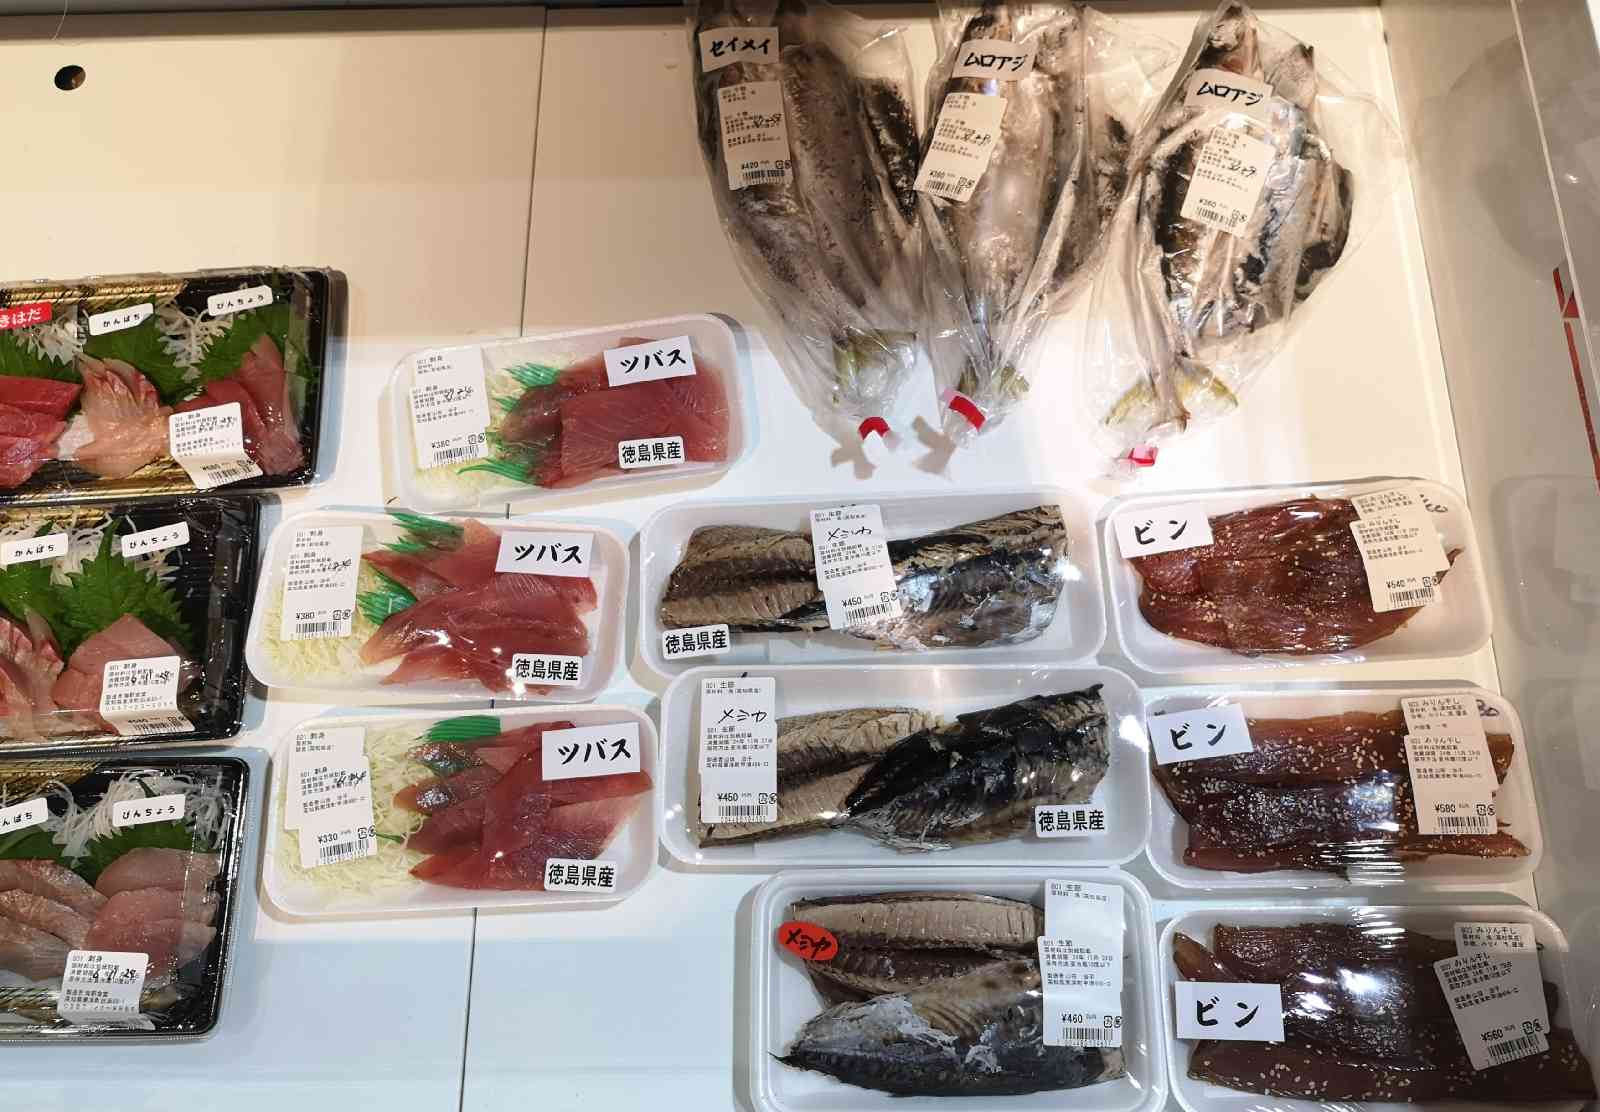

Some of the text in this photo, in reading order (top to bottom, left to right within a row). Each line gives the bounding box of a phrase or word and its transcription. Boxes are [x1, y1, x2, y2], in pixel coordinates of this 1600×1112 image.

[709, 36, 771, 58] セイメイ
[963, 52, 1029, 73] ムロアジ
[1196, 81, 1265, 107] ムロアジ
[619, 349, 688, 375] ツバス
[621, 439, 683, 464] 徳島県産
[1135, 519, 1188, 545] ビン
[514, 543, 583, 564] ツバス
[664, 627, 728, 653] 徳島県産
[514, 657, 580, 682] 徳島県産
[1169, 719, 1227, 751] ビン
[557, 738, 633, 765] ツバス
[1038, 809, 1106, 832] 徳島県産
[1435, 802, 1456, 814] ¥580
[318, 832, 339, 844] ¥330
[547, 863, 616, 888] 徳島県産
[1062, 1013, 1083, 1024] ¥460
[1195, 994, 1260, 1029] ビン
